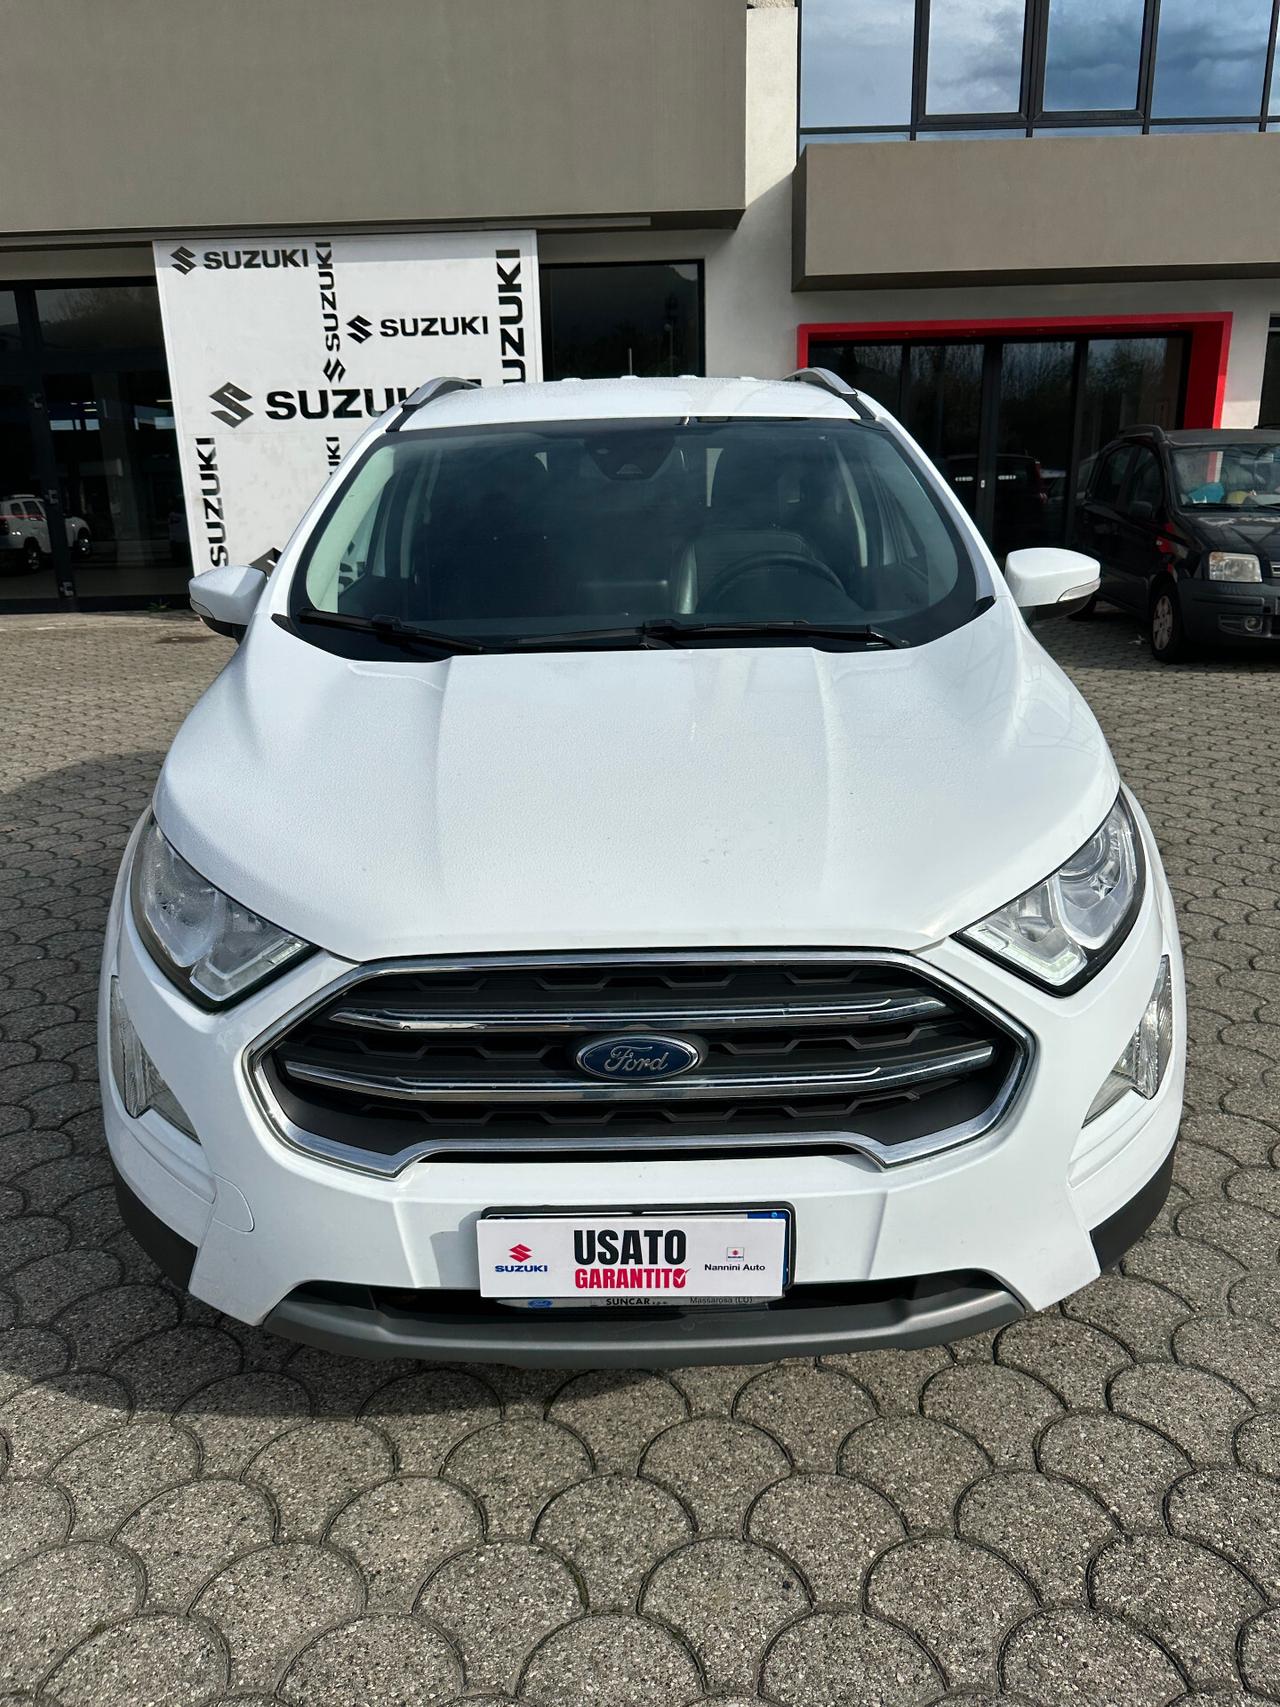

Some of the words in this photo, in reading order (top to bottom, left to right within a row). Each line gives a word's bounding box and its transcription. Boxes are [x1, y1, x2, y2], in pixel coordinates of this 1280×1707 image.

[203, 248, 309, 270] SUZUKI
[315, 242, 340, 352] SUZUKI
[380, 316, 489, 337] SUZUKI
[495, 249, 526, 384] UZUKI
[265, 387, 408, 420] SUZU
[195, 437, 229, 567] SUZUKI
[604, 1045, 669, 1072] Ford
[573, 1229, 687, 1265] USATO
[495, 1265, 548, 1273] SUZUKI
[575, 1268, 690, 1289] GARANTITO
[606, 1298, 650, 1306] SUNCAR
